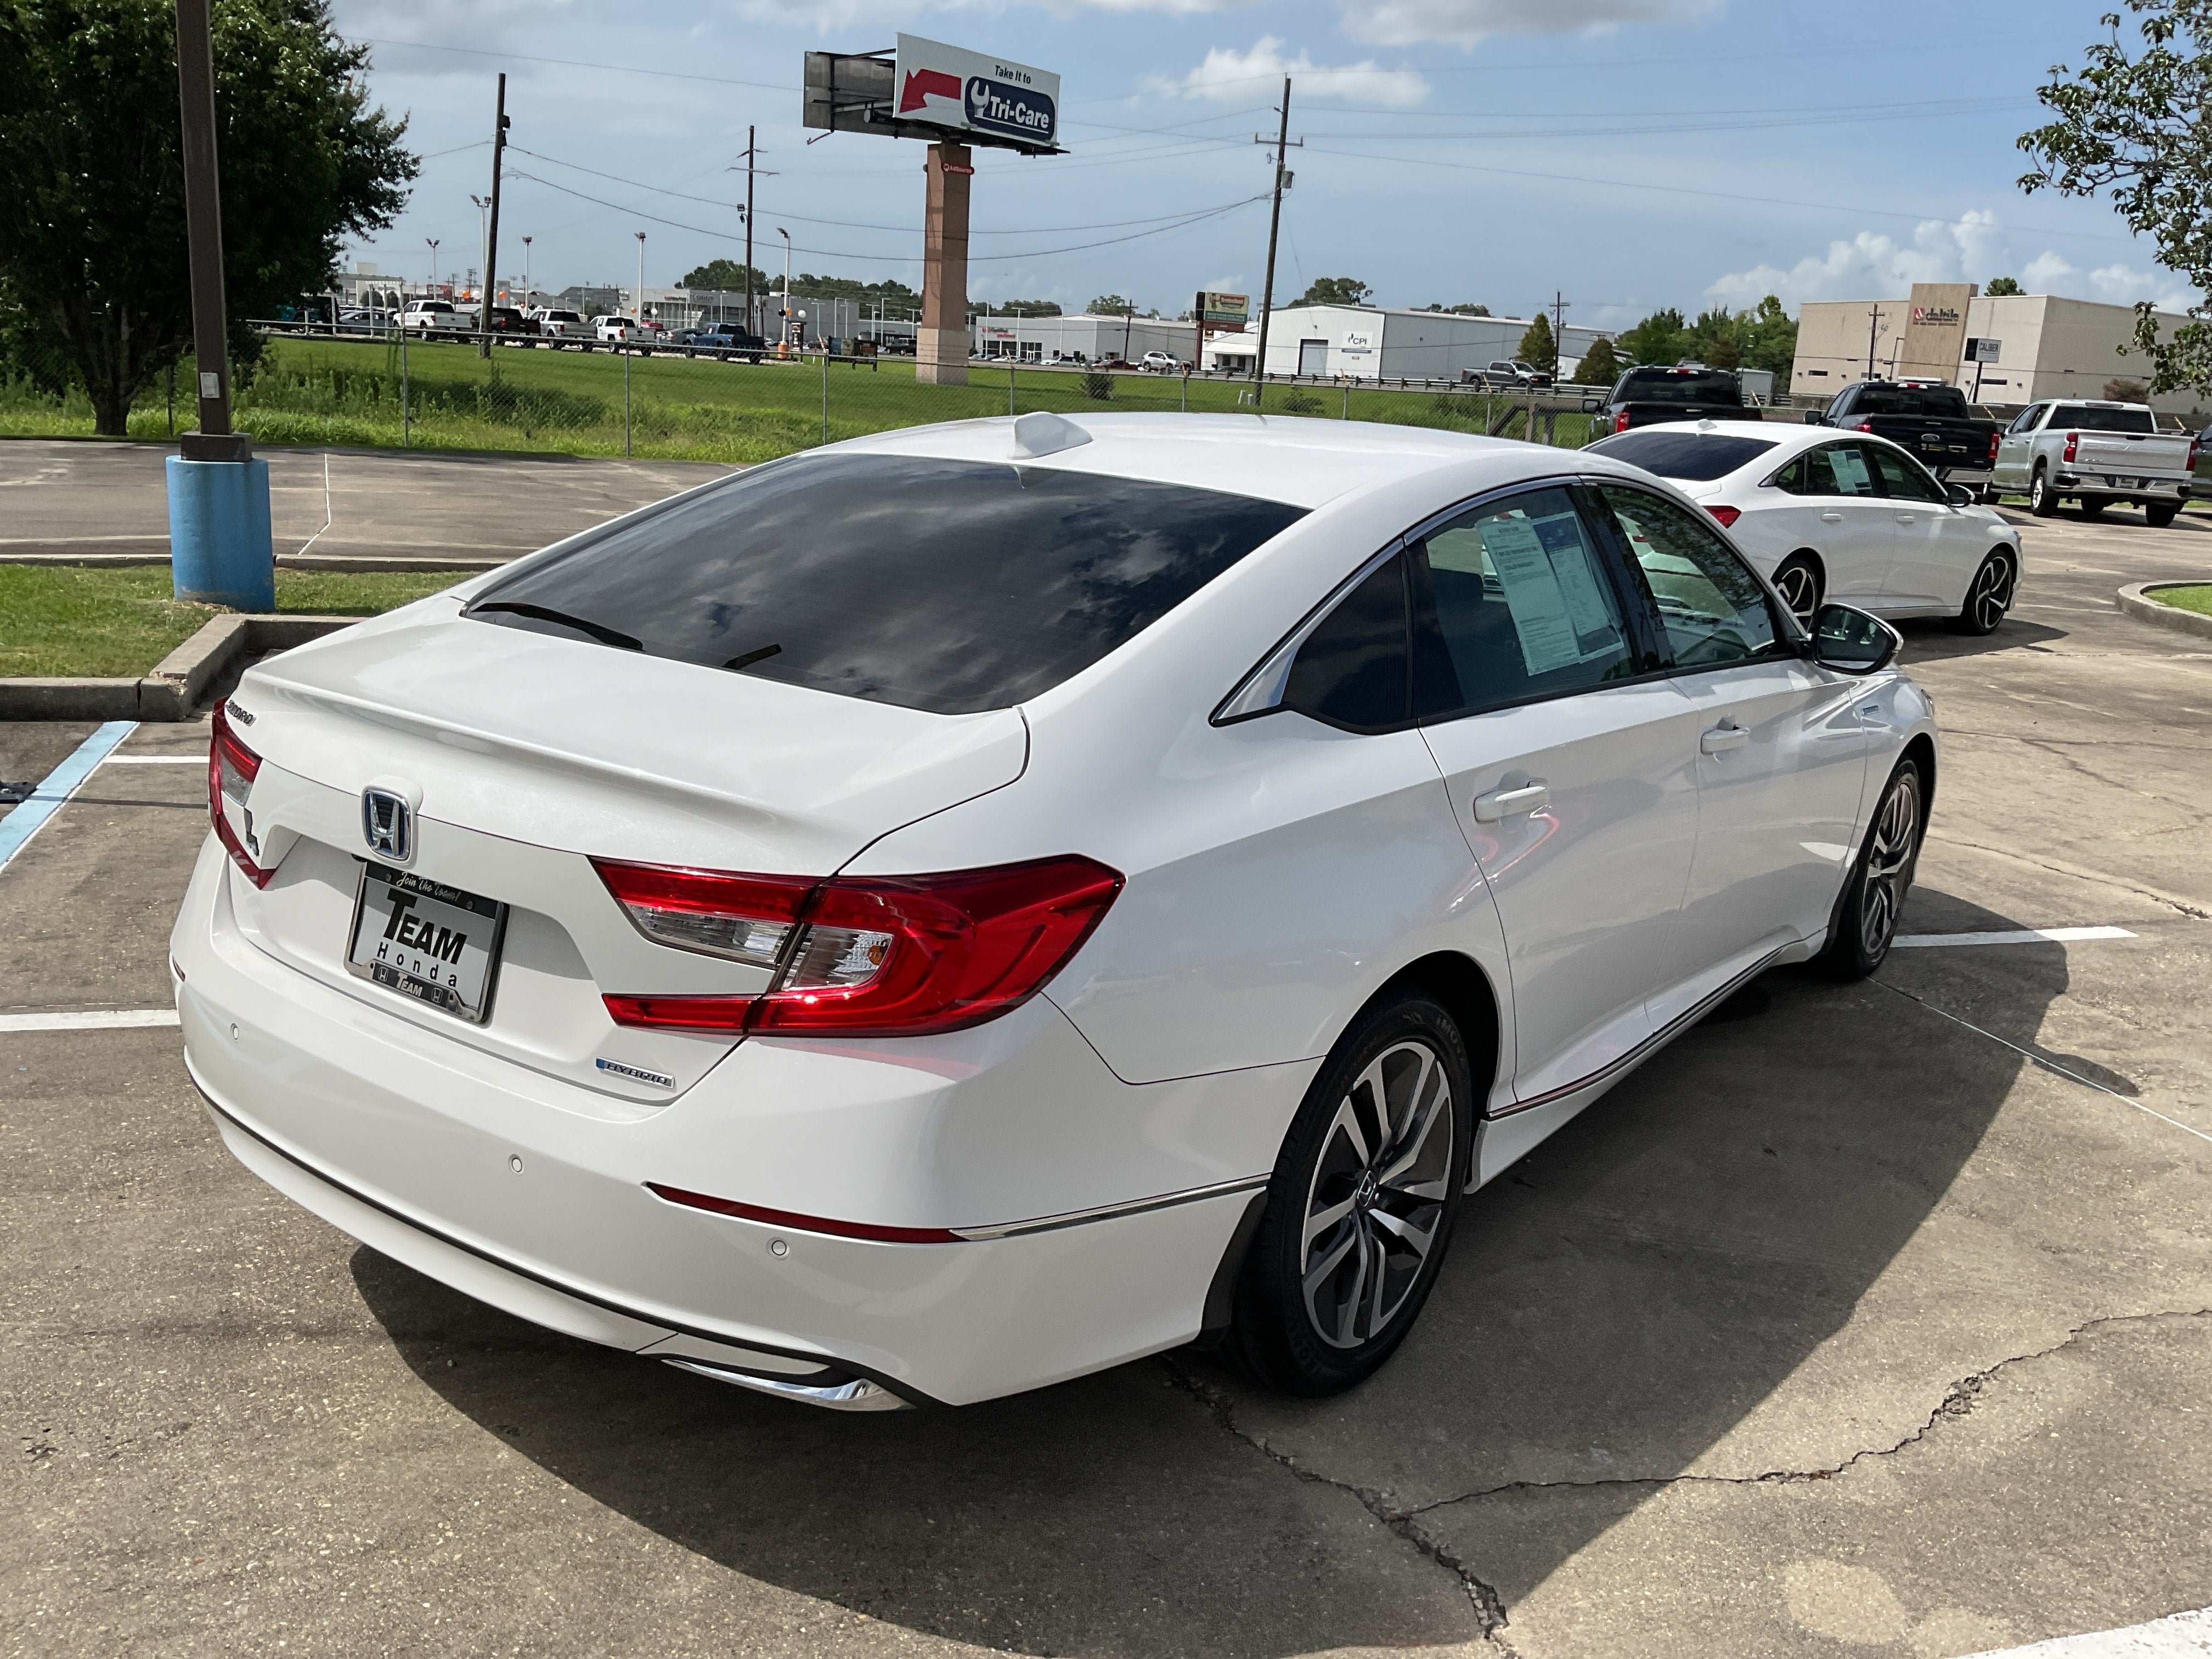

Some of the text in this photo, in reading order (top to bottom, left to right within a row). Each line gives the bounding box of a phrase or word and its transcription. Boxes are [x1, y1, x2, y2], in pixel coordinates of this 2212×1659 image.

[995, 65, 1031, 84] Take It to
[990, 95, 1049, 129] Tri-Care
[1979, 342, 1999, 352] CALIBER
[396, 871, 416, 887] Join
[419, 877, 433, 892] The
[383, 888, 467, 965] TEAM
[377, 941, 457, 988] Honda
[396, 972, 422, 997] TEAM
[607, 1063, 667, 1084] HYBRID
